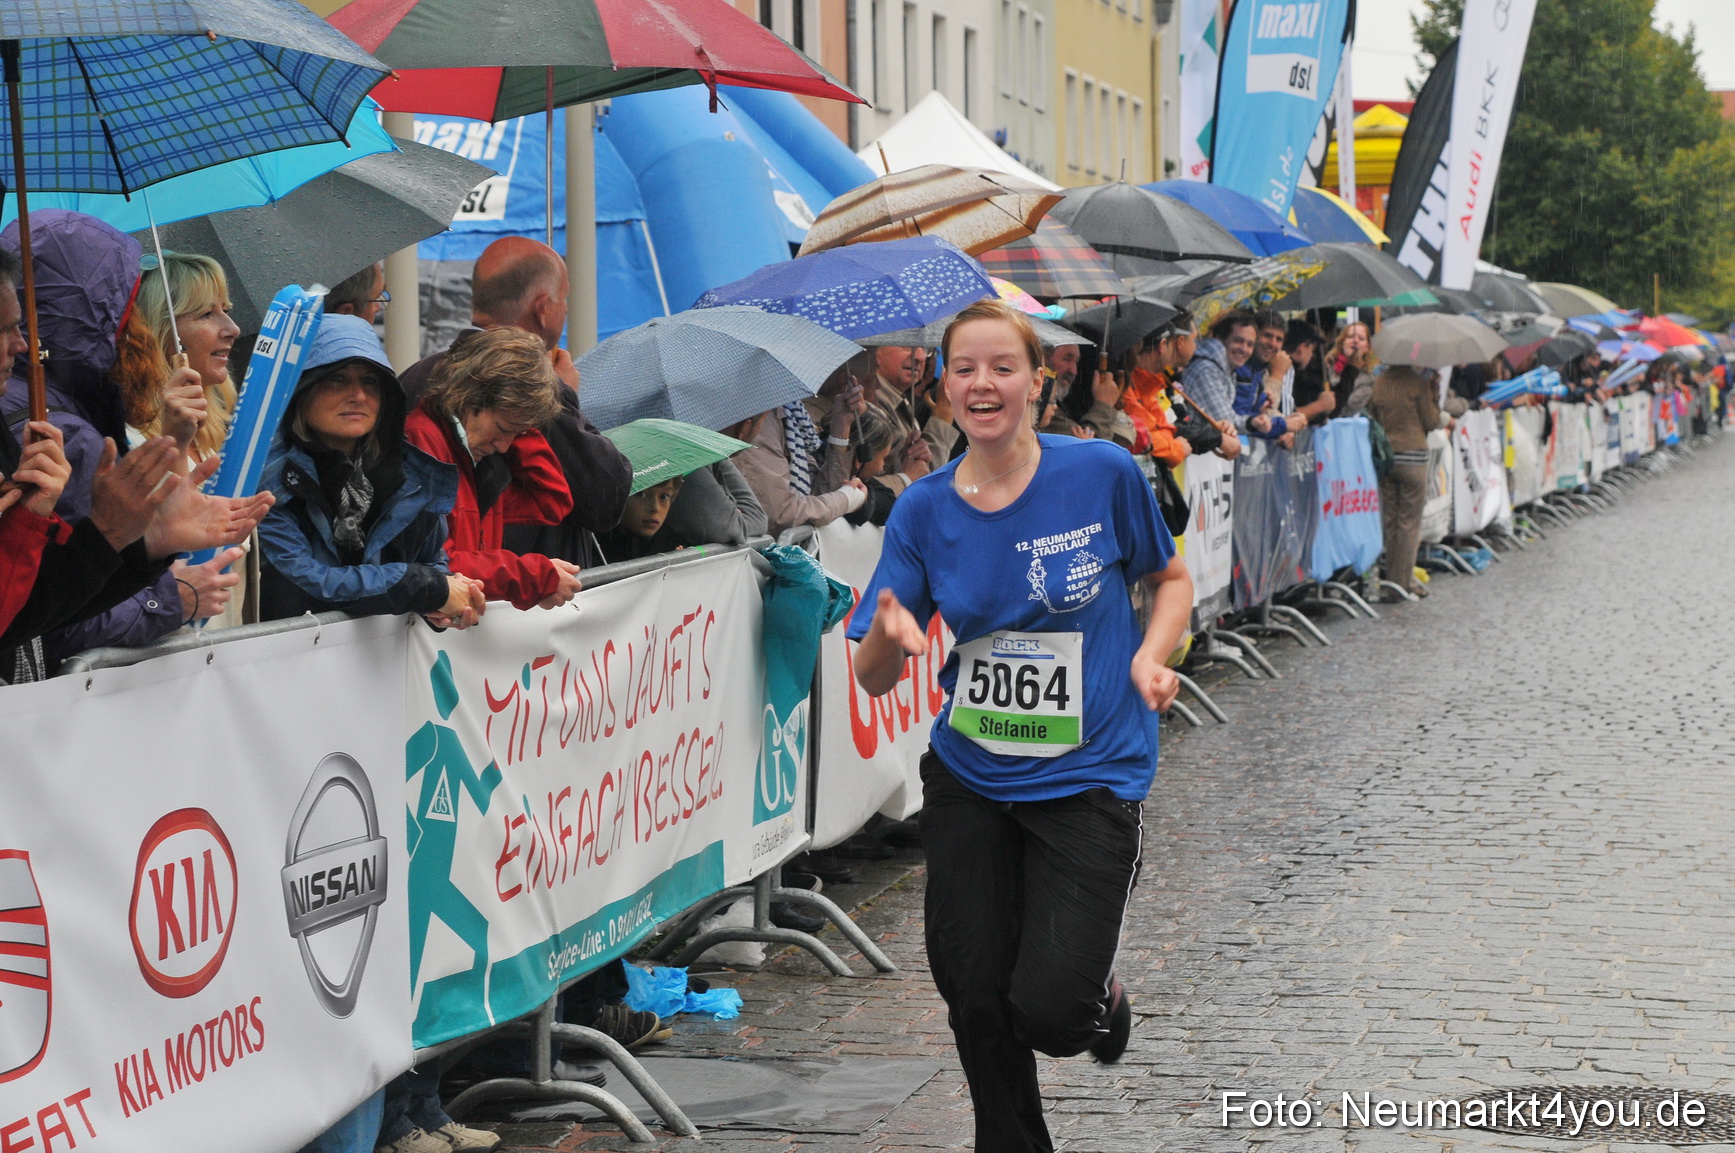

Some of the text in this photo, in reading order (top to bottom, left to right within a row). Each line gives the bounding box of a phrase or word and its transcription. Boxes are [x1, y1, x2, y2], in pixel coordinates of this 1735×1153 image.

[1257, 3, 1321, 39] maxi
[1289, 62, 1312, 91] dsl
[1460, 60, 1499, 241] Audi BKK
[461, 184, 491, 213] sl
[1015, 523, 1102, 552] 12. NEUMARKTER
[1032, 536, 1091, 558] STADTLAUF
[993, 637, 1040, 651] BOCK
[559, 639, 616, 750] UNS
[968, 659, 1070, 711] 5064
[979, 715, 1047, 739] Stefanie
[633, 721, 724, 844] BESSER
[148, 848, 224, 961] KIA
[289, 855, 377, 920] NISSAN
[114, 996, 265, 1119] KIA MOTORS
